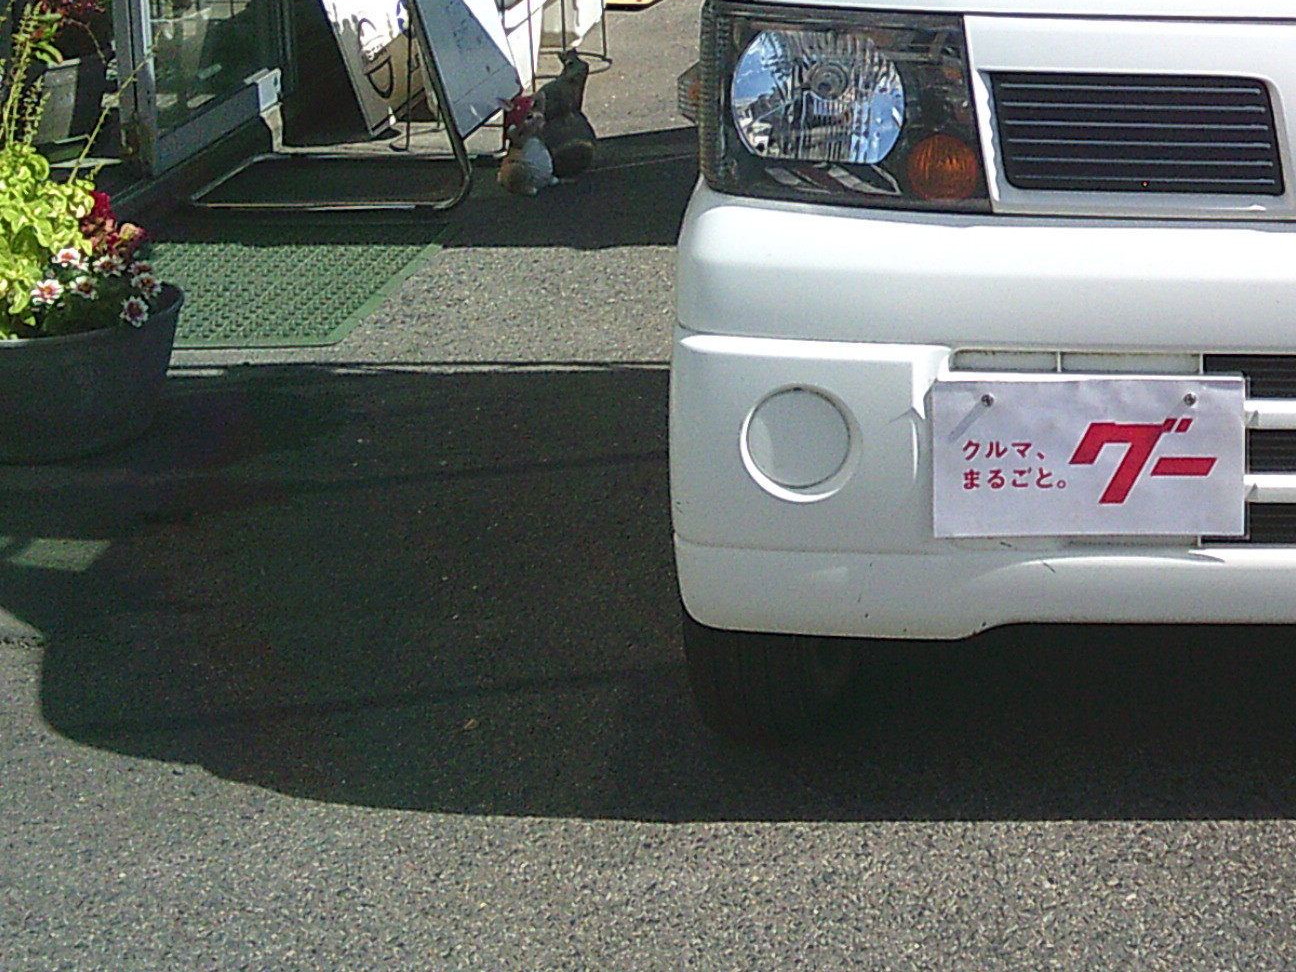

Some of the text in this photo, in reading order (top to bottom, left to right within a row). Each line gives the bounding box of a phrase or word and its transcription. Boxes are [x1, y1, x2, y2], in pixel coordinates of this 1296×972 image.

[962, 440, 1046, 461] クルマ、
[1068, 417, 1217, 504] グー
[962, 468, 1067, 490] まるごと。
